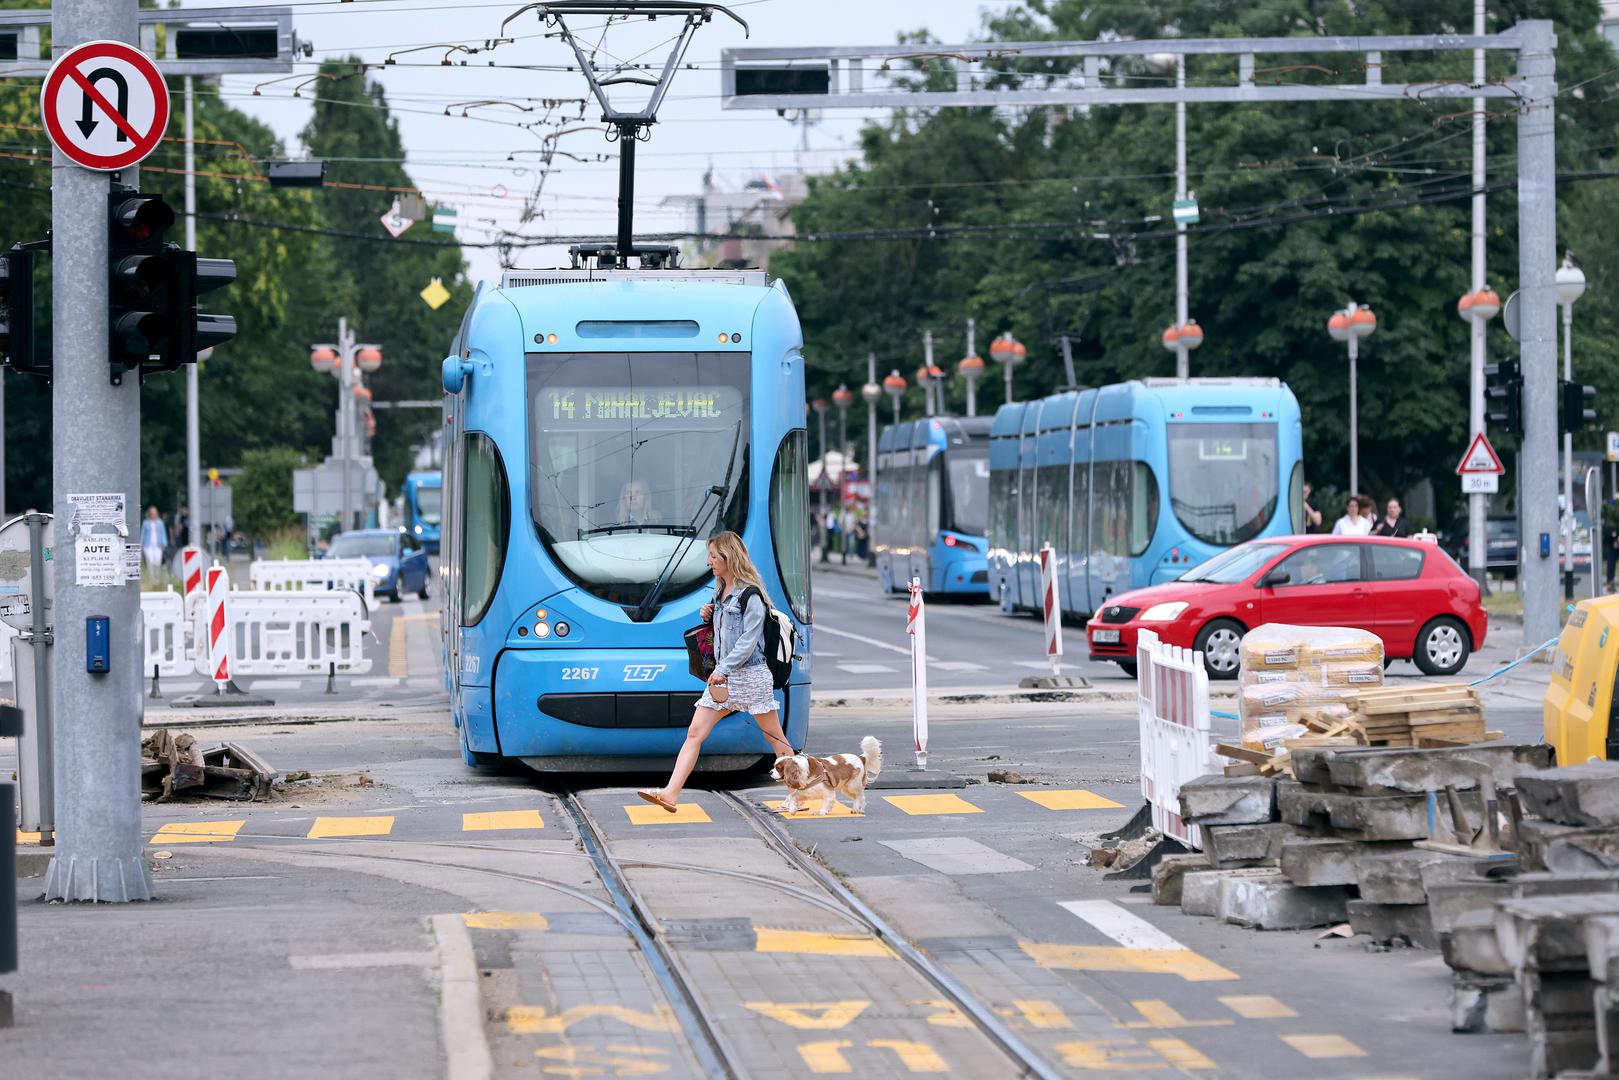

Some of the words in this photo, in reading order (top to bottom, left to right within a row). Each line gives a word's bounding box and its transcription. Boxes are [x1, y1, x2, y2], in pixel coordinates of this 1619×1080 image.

[549, 388, 576, 420] 14
[583, 390, 722, 420] MIHALJEVAC
[1471, 479, 1482, 489] 30
[83, 545, 111, 554] AUTE
[561, 667, 600, 680] 2267
